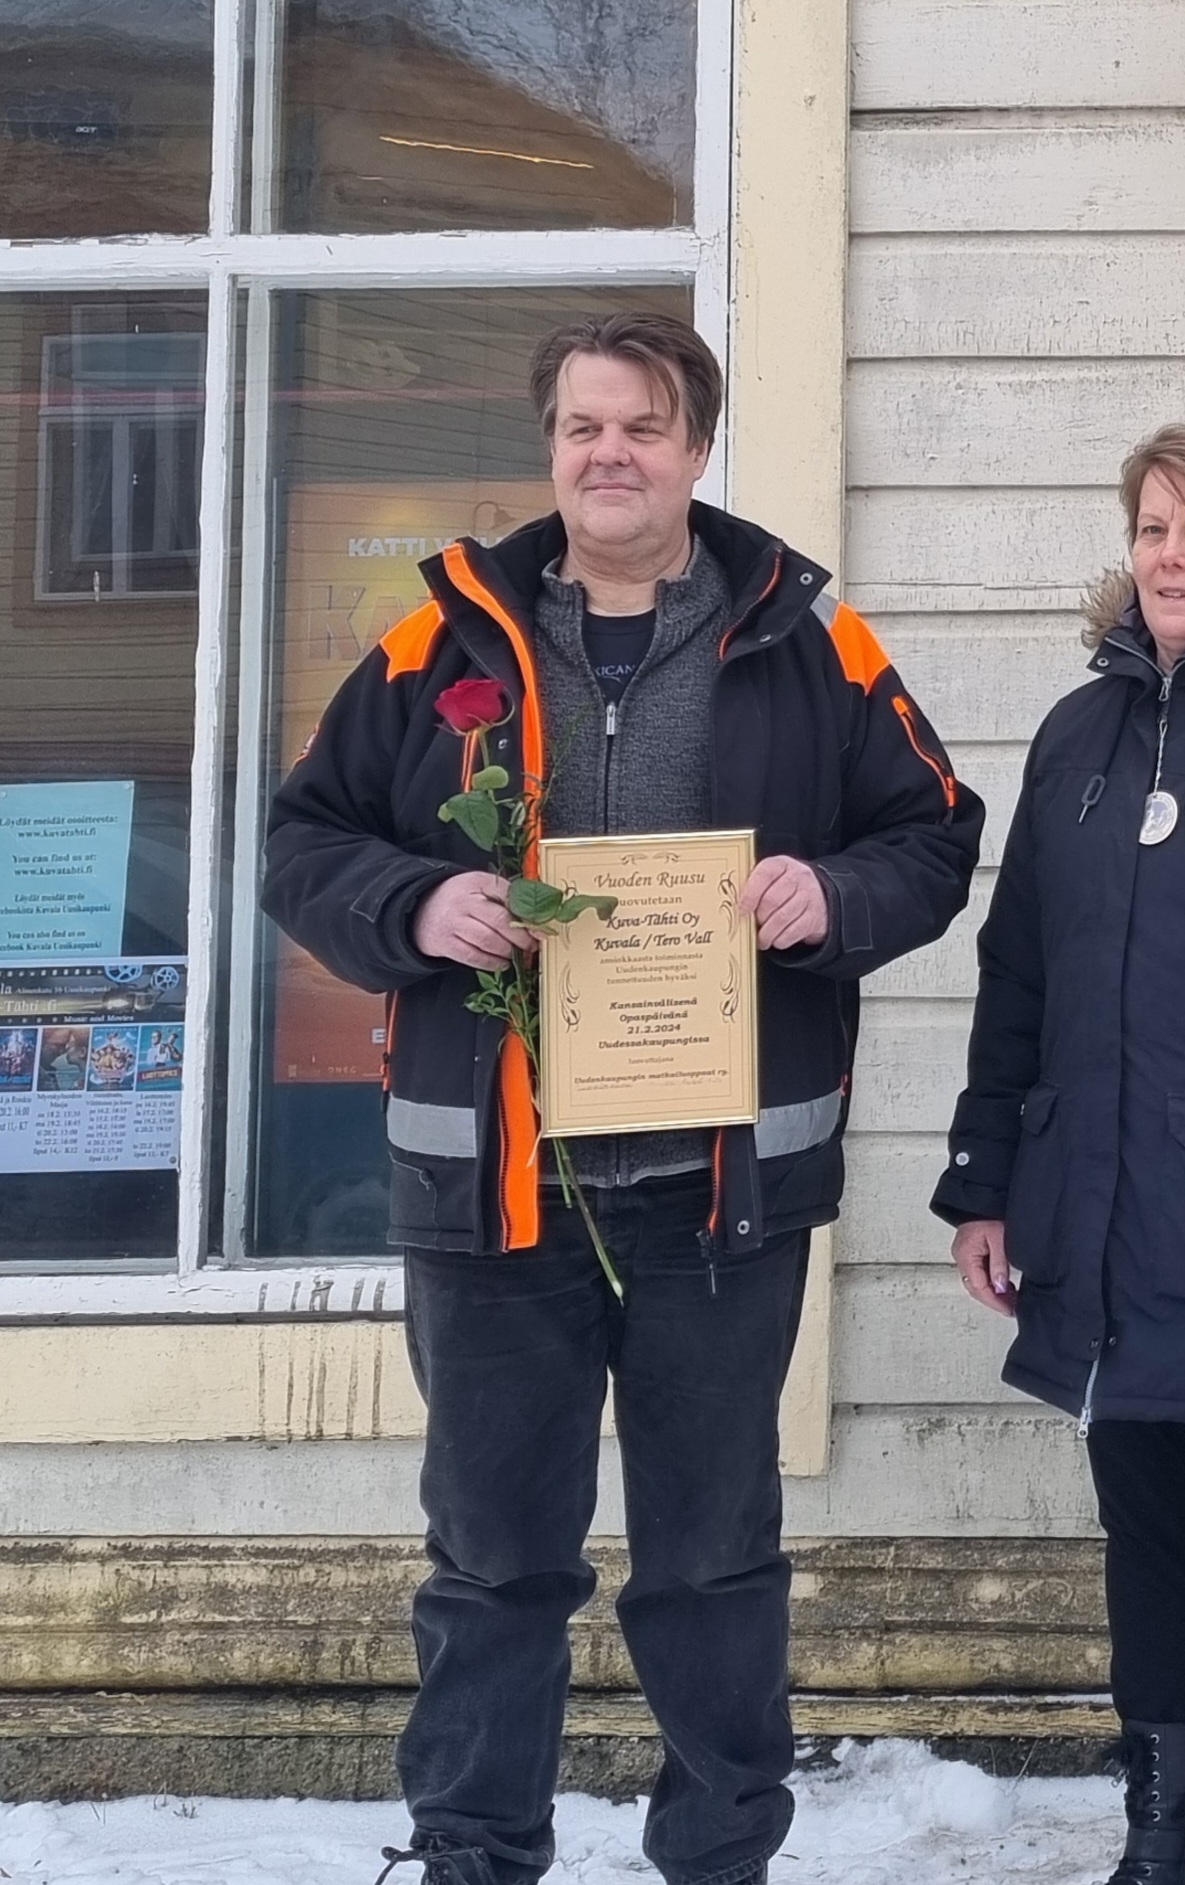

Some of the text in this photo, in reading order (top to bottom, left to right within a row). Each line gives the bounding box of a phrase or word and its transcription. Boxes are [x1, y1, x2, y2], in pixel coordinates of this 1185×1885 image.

[348, 537, 427, 557] KATTI
[51, 854, 70, 863] find
[594, 871, 705, 888] Vuoden Ruusu
[619, 896, 682, 907] uovutetaan
[606, 912, 700, 930] Kuva-Tähti Oy
[594, 930, 714, 951] Kuvala / Tero Vall
[609, 997, 698, 1010] Kansainvälisenä
[619, 1010, 688, 1023] Opaspäivänä
[626, 1023, 682, 1035] 21.2.2024
[598, 1036, 710, 1049] Uudessakaupungissa
